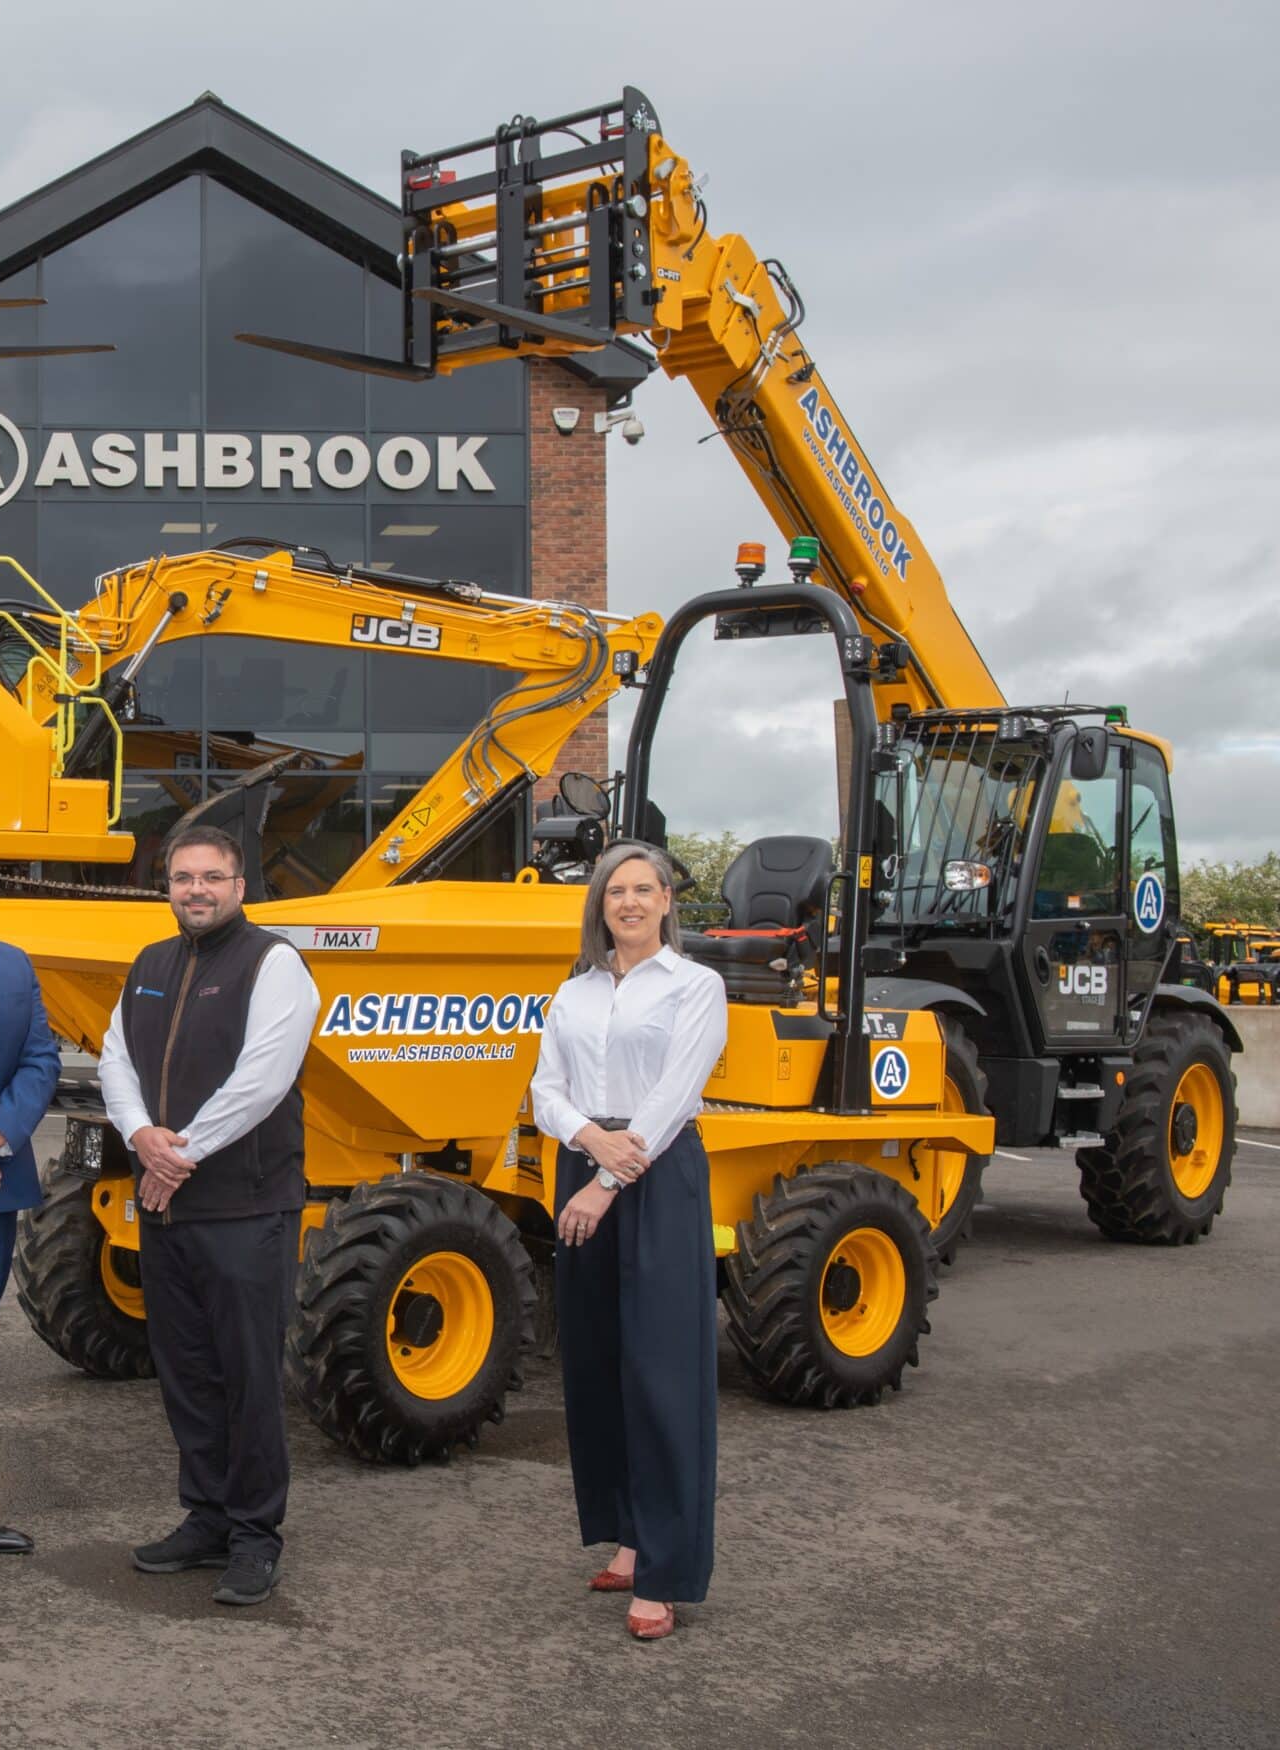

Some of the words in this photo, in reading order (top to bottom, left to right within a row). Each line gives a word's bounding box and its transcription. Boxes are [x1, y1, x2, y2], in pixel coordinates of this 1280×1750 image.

[34, 432, 496, 492] ASHBROOK
[799, 387, 912, 581] ASHBROOK
[803, 428, 890, 576] www.ASHBROOK.Ltd
[352, 617, 440, 649] JCB
[322, 932, 362, 948] MAX
[1059, 964, 1108, 995] JCB
[321, 994, 552, 1035] ASHBROOK
[348, 1044, 515, 1063] www.ASHBROOK.Ltd
